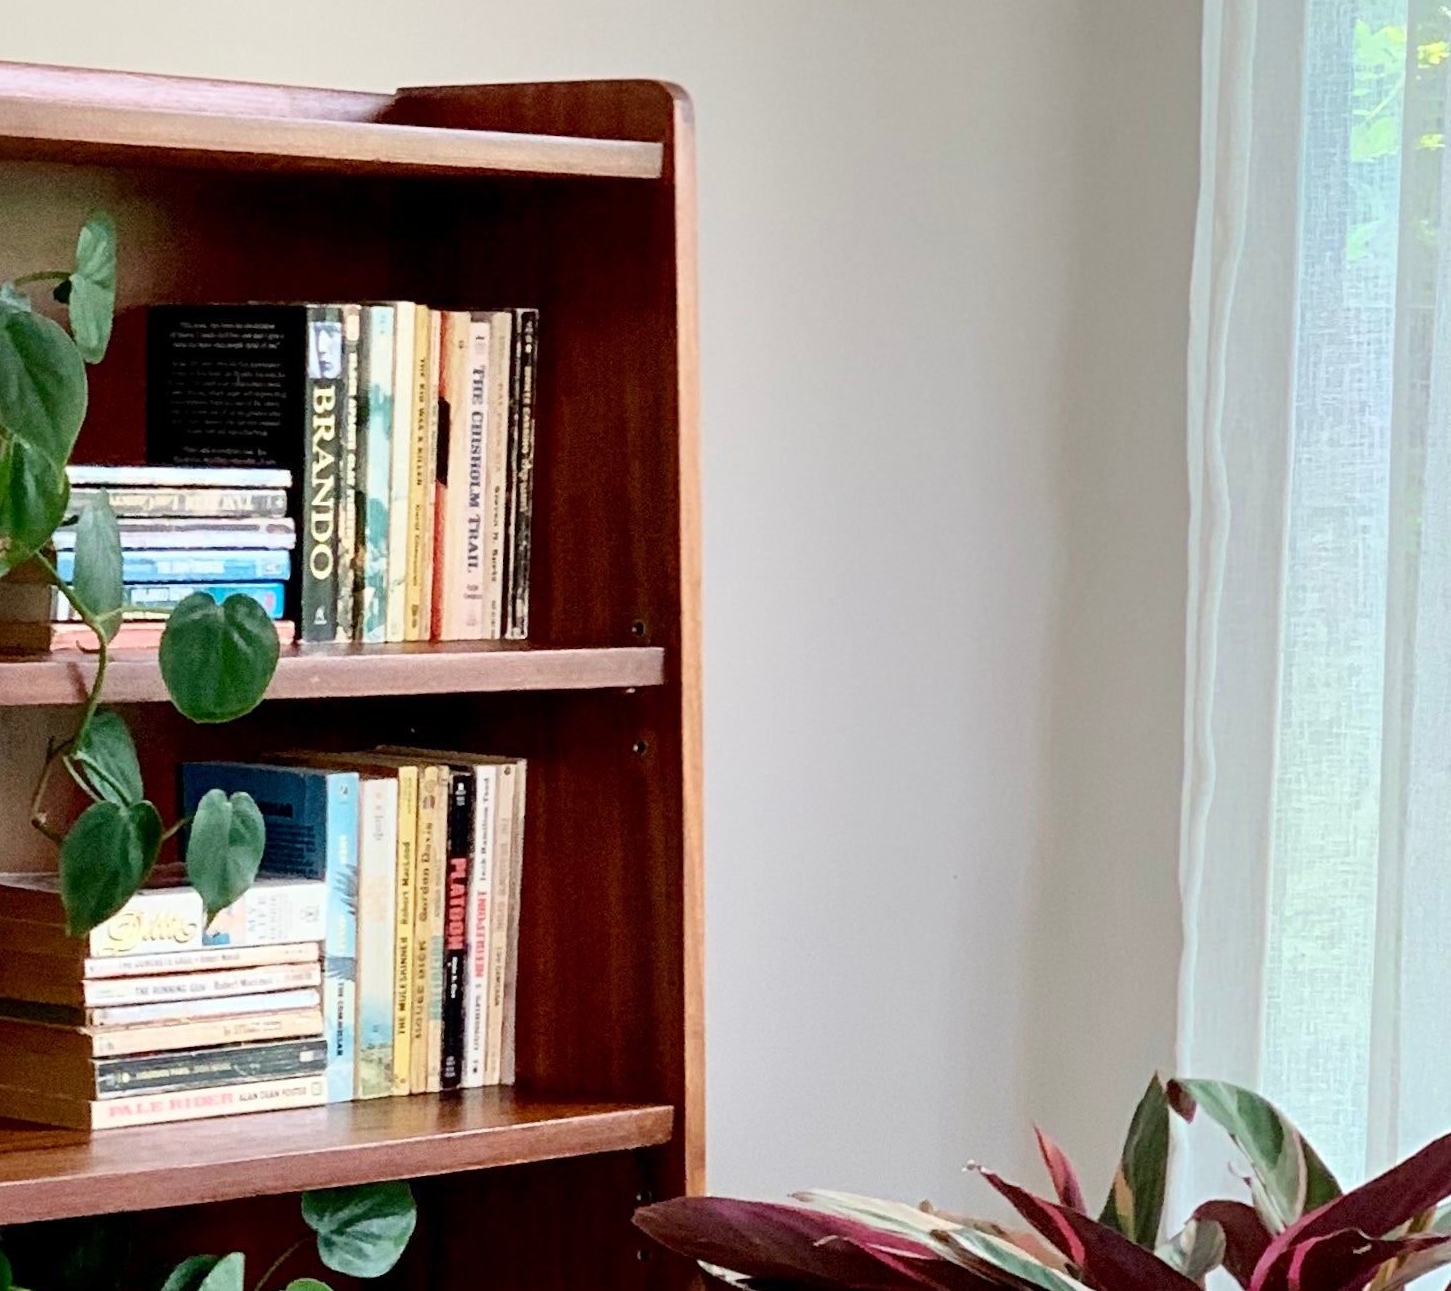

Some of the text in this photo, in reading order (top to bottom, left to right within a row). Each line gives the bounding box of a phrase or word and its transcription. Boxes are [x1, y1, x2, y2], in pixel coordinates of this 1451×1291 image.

[310, 385, 335, 580] BRANDO
[467, 366, 486, 573] THE CHISHOLM TRAIL
[421, 822, 433, 863] Davis
[480, 806, 489, 855] Hamilton
[418, 868, 430, 922] Gordon
[479, 858, 487, 881] Jack
[447, 857, 467, 950] PLATOON
[398, 842, 410, 1035] THE MULESKINNER Robert MacLeod
[135, 986, 148, 996] THE
[152, 984, 187, 995] RUNNING
[335, 982, 345, 1057] THE COMMISSAR
[108, 1086, 307, 1118] PALE RIDER ALAN DEAN FOSTER
